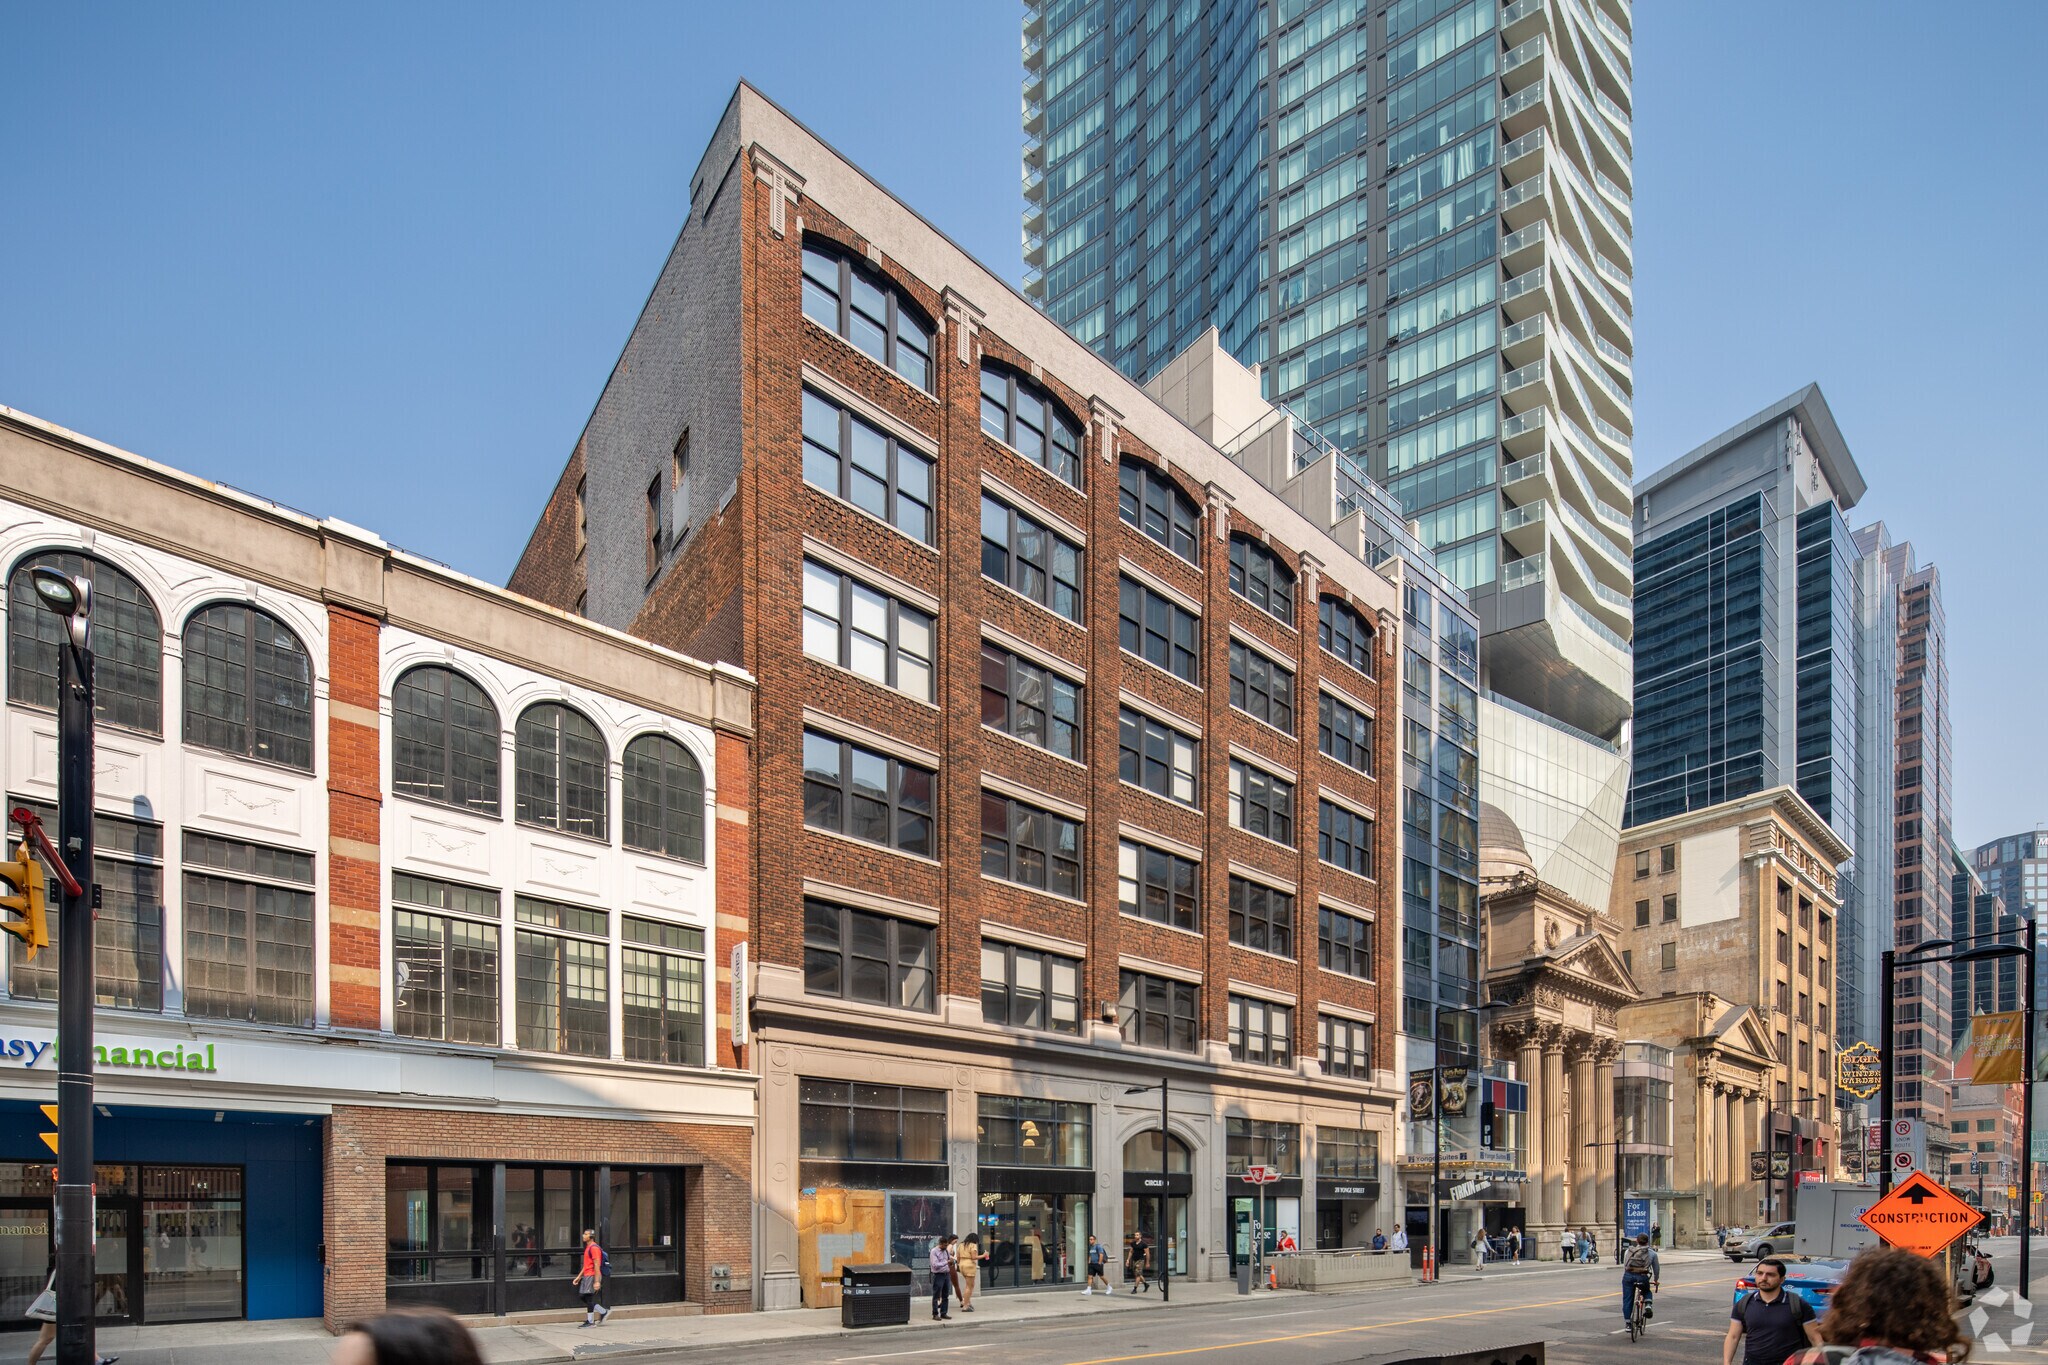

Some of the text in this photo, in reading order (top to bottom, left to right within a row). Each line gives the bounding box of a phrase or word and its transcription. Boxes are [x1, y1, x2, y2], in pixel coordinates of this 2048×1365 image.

[1973, 1038, 2022, 1047] TORONTO'S
[1979, 1044, 2022, 1052] CULTURAL
[1843, 1055, 1881, 1063] ELGIN
[1450, 1180, 1476, 1201] FIRKIN
[1870, 1212, 1968, 1224] CONSTRUCTION
[1253, 1230, 1271, 1239] Lese
